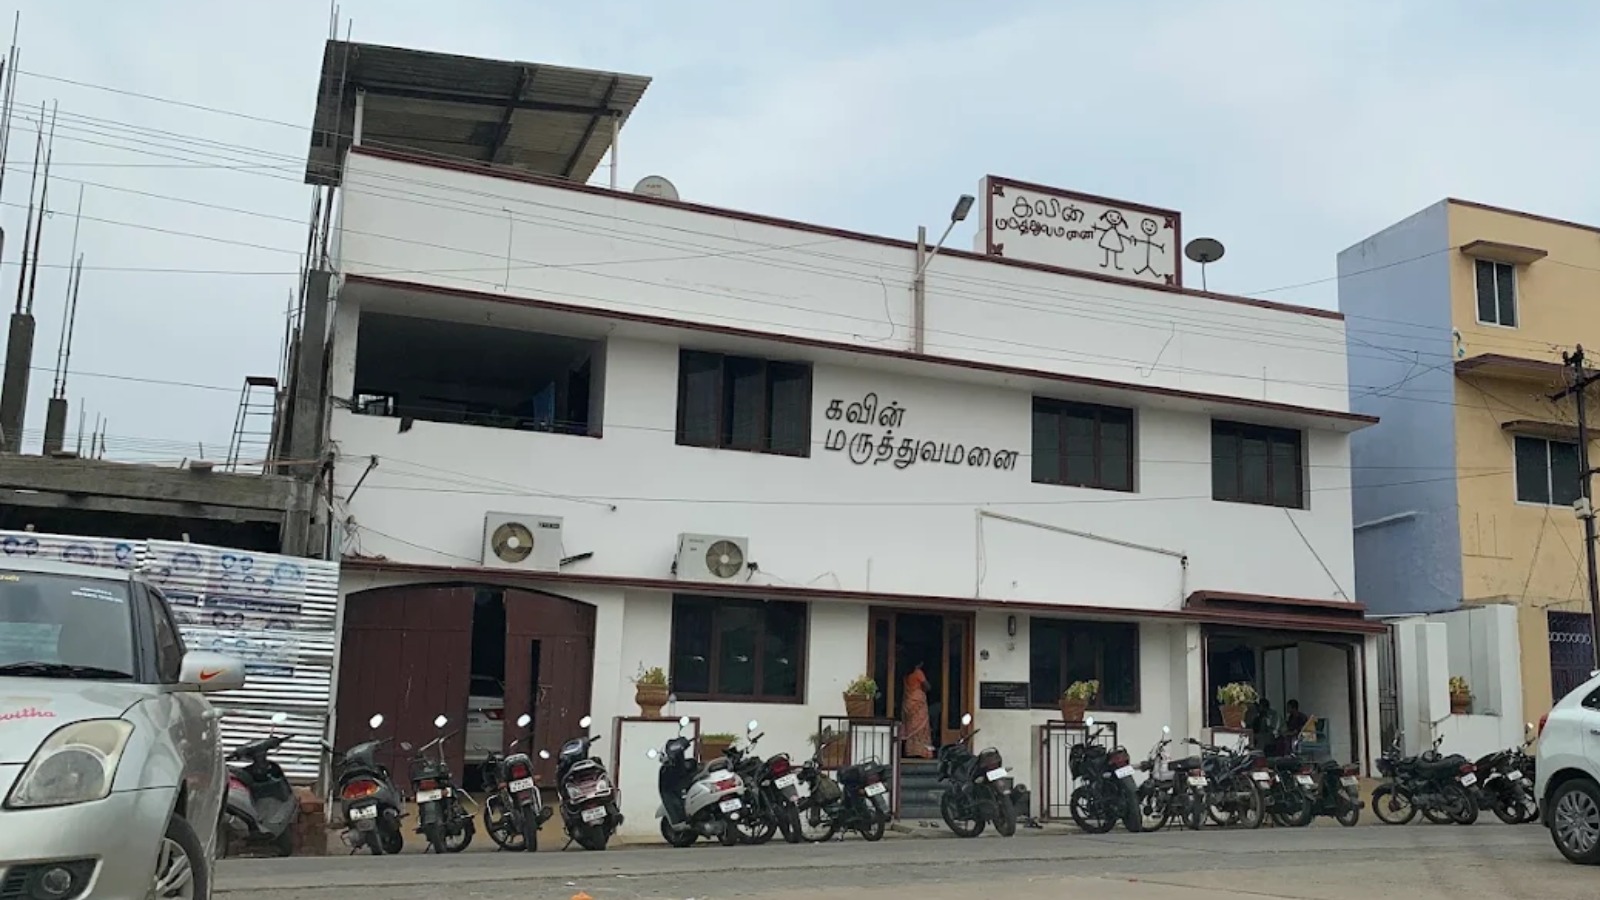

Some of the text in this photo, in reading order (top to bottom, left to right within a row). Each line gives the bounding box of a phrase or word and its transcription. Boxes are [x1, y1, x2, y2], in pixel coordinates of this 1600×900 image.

[1012, 196, 1085, 223] கவின்
[825, 392, 906, 427] கவின்
[825, 429, 1019, 469] மருத்துவமனை
